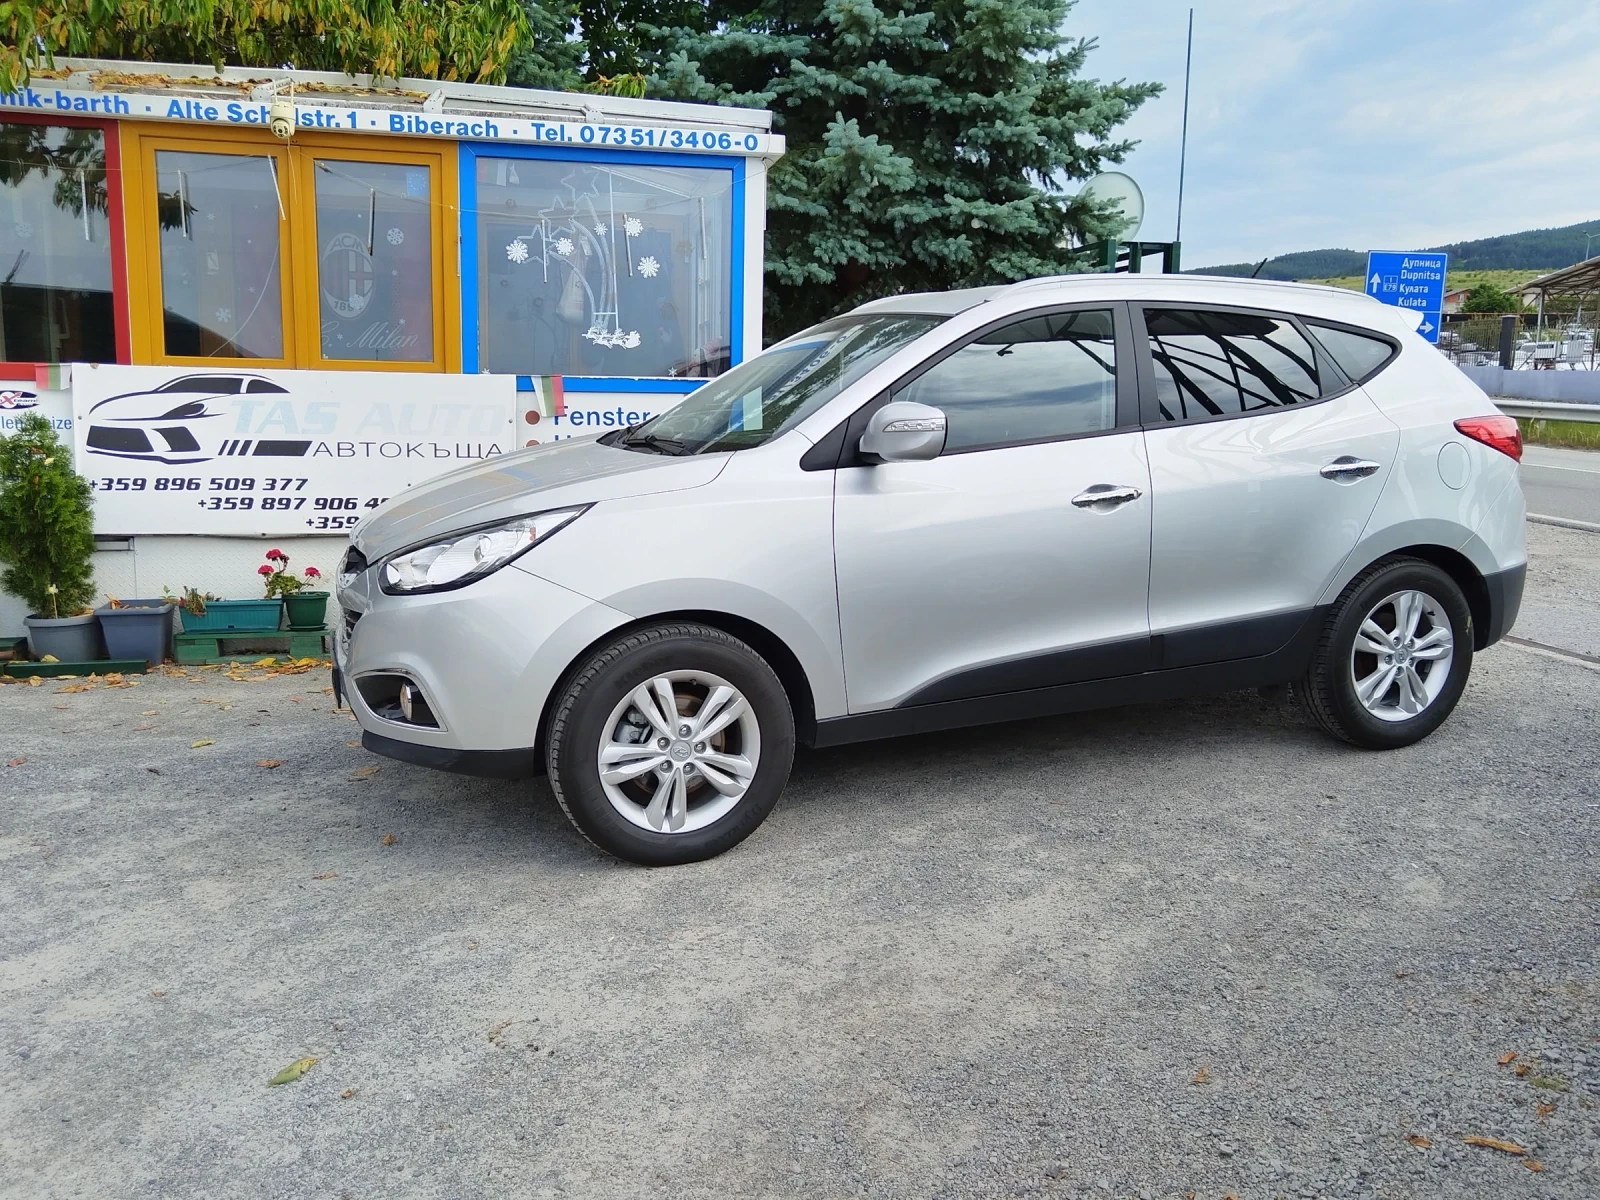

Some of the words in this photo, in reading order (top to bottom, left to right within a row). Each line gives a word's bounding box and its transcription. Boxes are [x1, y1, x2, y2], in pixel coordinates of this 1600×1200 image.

[167, 99, 218, 121] Alte
[227, 103, 341, 128] Schlstr.
[389, 114, 498, 138] Biberach
[531, 122, 573, 142] Tel.
[1402, 257, 1441, 269] Дупница
[1401, 269, 1441, 281] Dupnitsa
[1400, 283, 1429, 295] Кулата
[1397, 296, 1427, 307] Kulata
[346, 321, 419, 349] Milan
[231, 400, 341, 435] TAS
[353, 403, 504, 437] AUTO
[312, 441, 502, 459] АВТОКЪЩА
[90, 478, 146, 491] +359
[154, 478, 201, 491] 896
[208, 478, 256, 491] 509
[262, 478, 309, 491] 377
[197, 497, 255, 510] +359
[260, 497, 307, 510] 897
[313, 497, 359, 510] 906
[305, 516, 361, 529] +359
